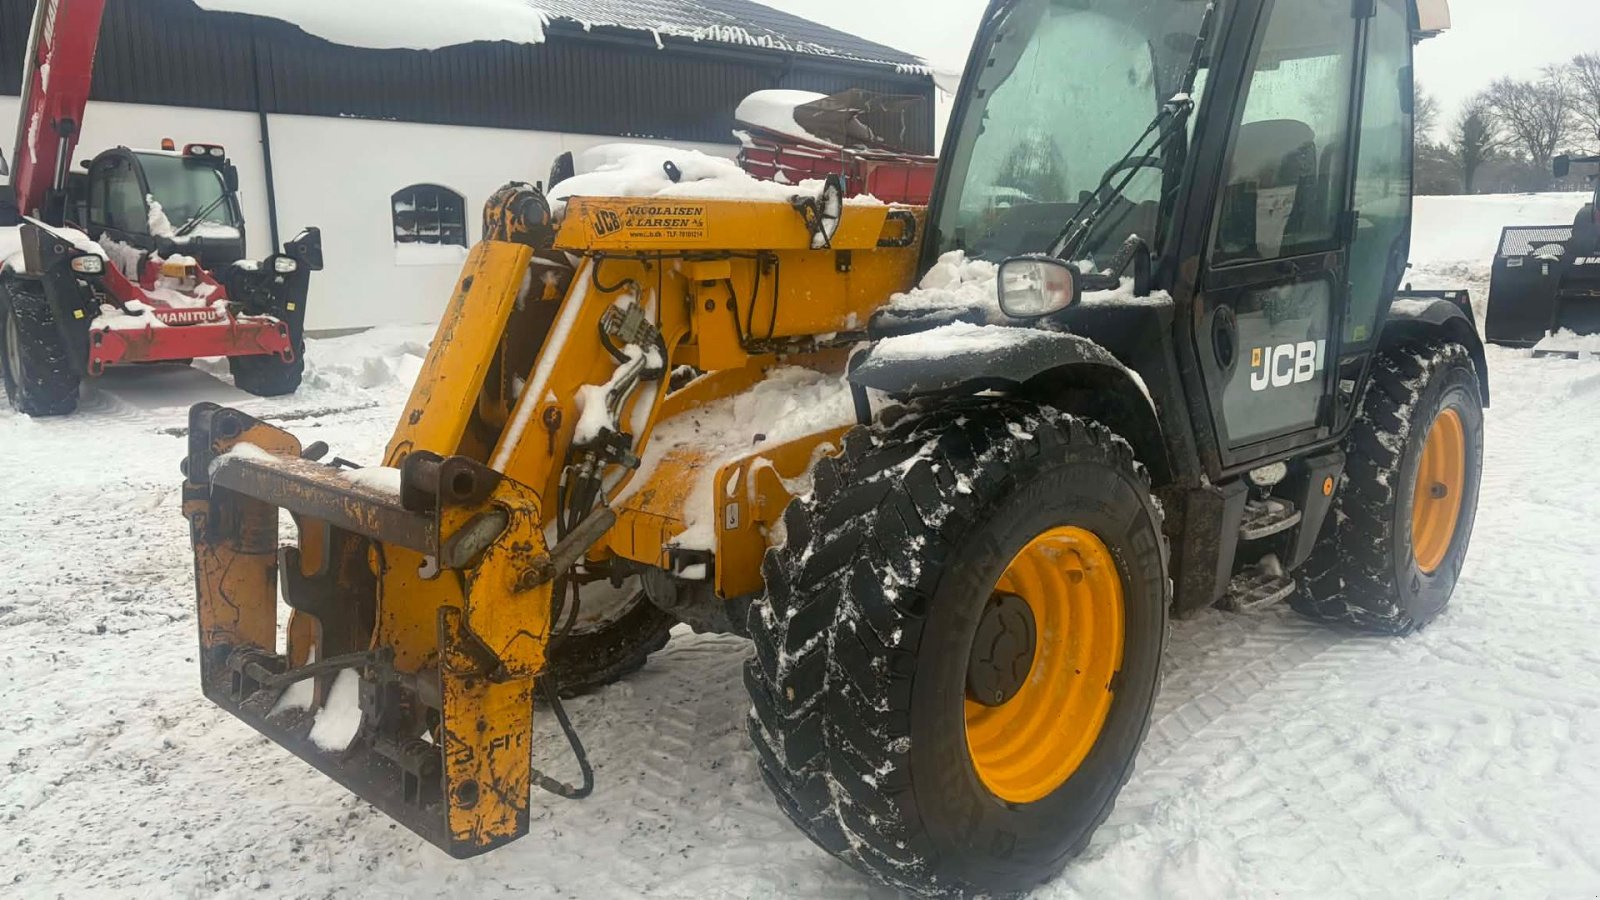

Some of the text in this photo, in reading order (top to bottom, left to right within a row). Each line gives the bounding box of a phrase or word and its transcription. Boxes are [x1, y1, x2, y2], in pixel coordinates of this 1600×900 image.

[625, 207, 703, 216] NICOLAISEN
[594, 209, 621, 236] JCB
[625, 219, 633, 227] &
[637, 218, 690, 227] LARSEN
[157, 311, 217, 323] MANITOU
[1250, 341, 1317, 391] JCB
